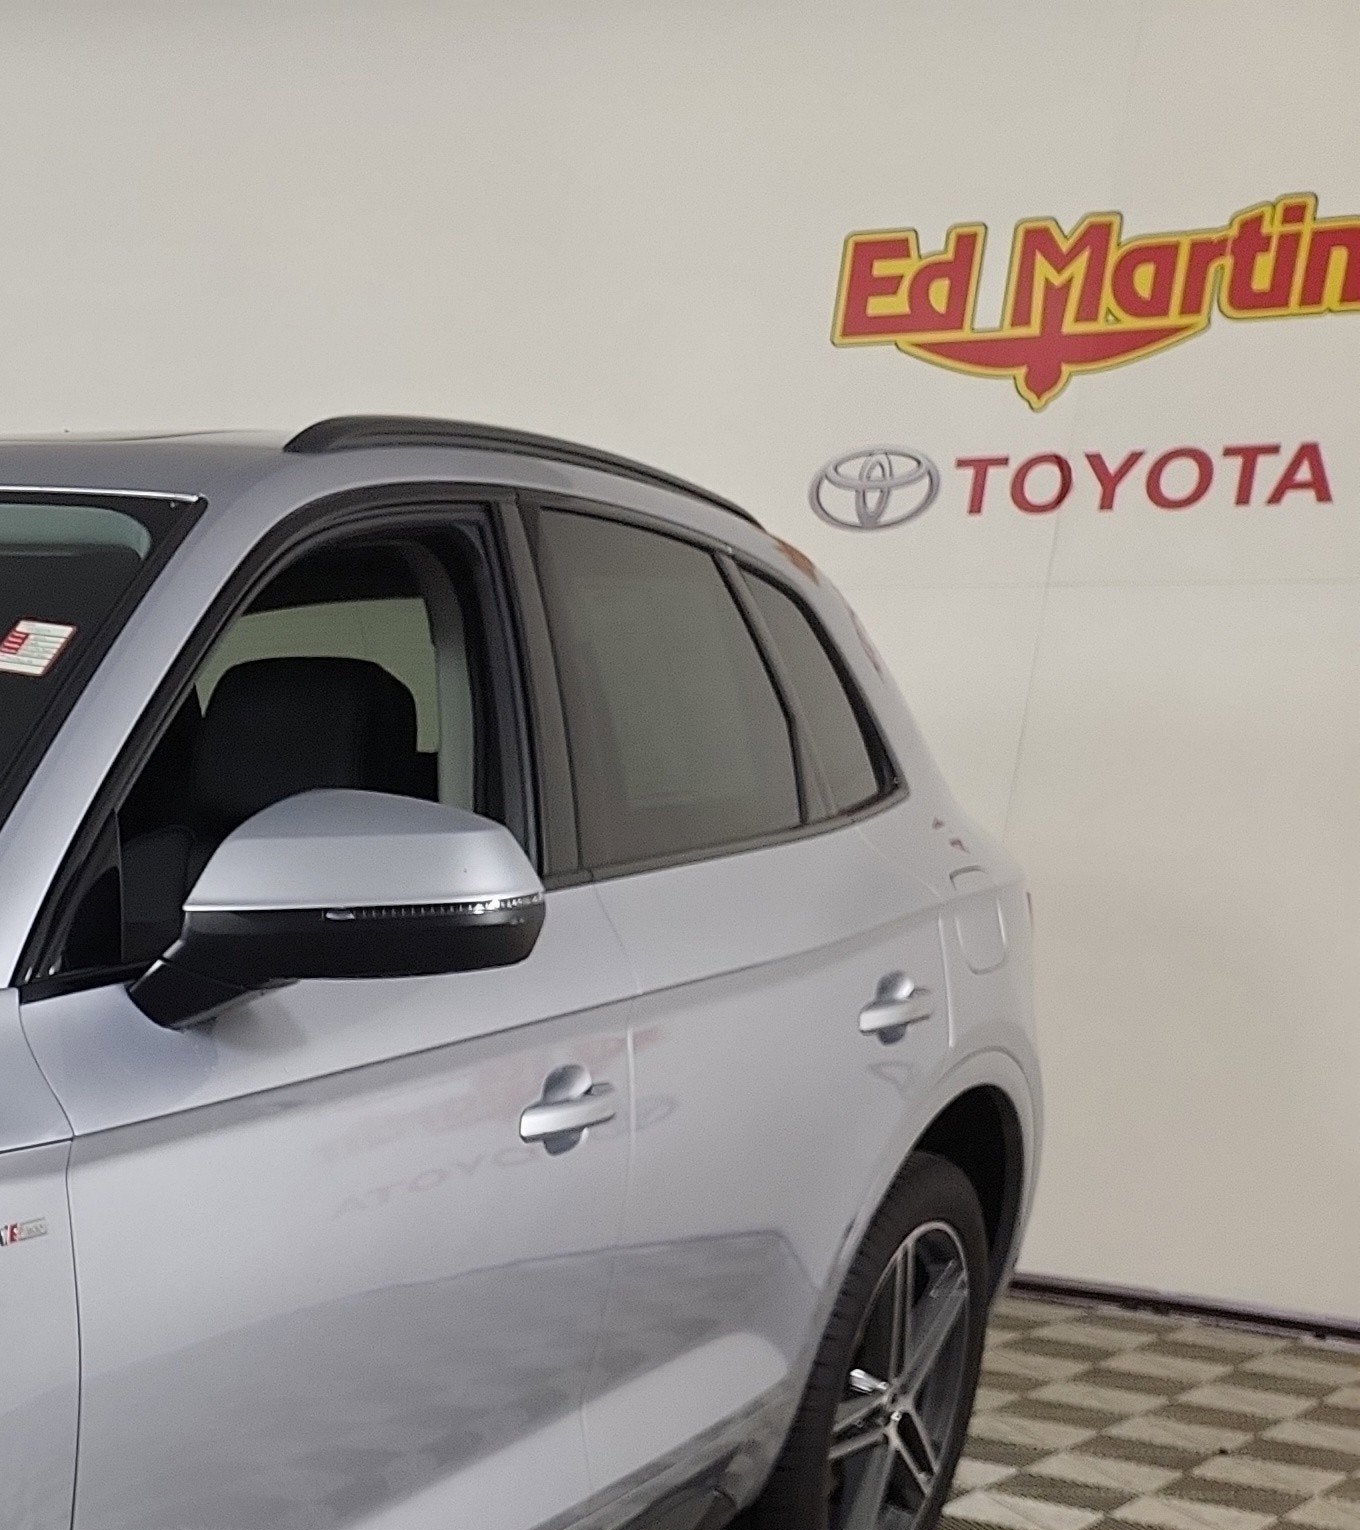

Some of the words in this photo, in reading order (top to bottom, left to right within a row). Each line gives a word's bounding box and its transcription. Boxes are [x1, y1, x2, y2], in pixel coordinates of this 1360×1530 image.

[840, 231, 979, 339] Ed
[1009, 202, 1360, 331] Martin
[955, 442, 1333, 514] TOYOTA
